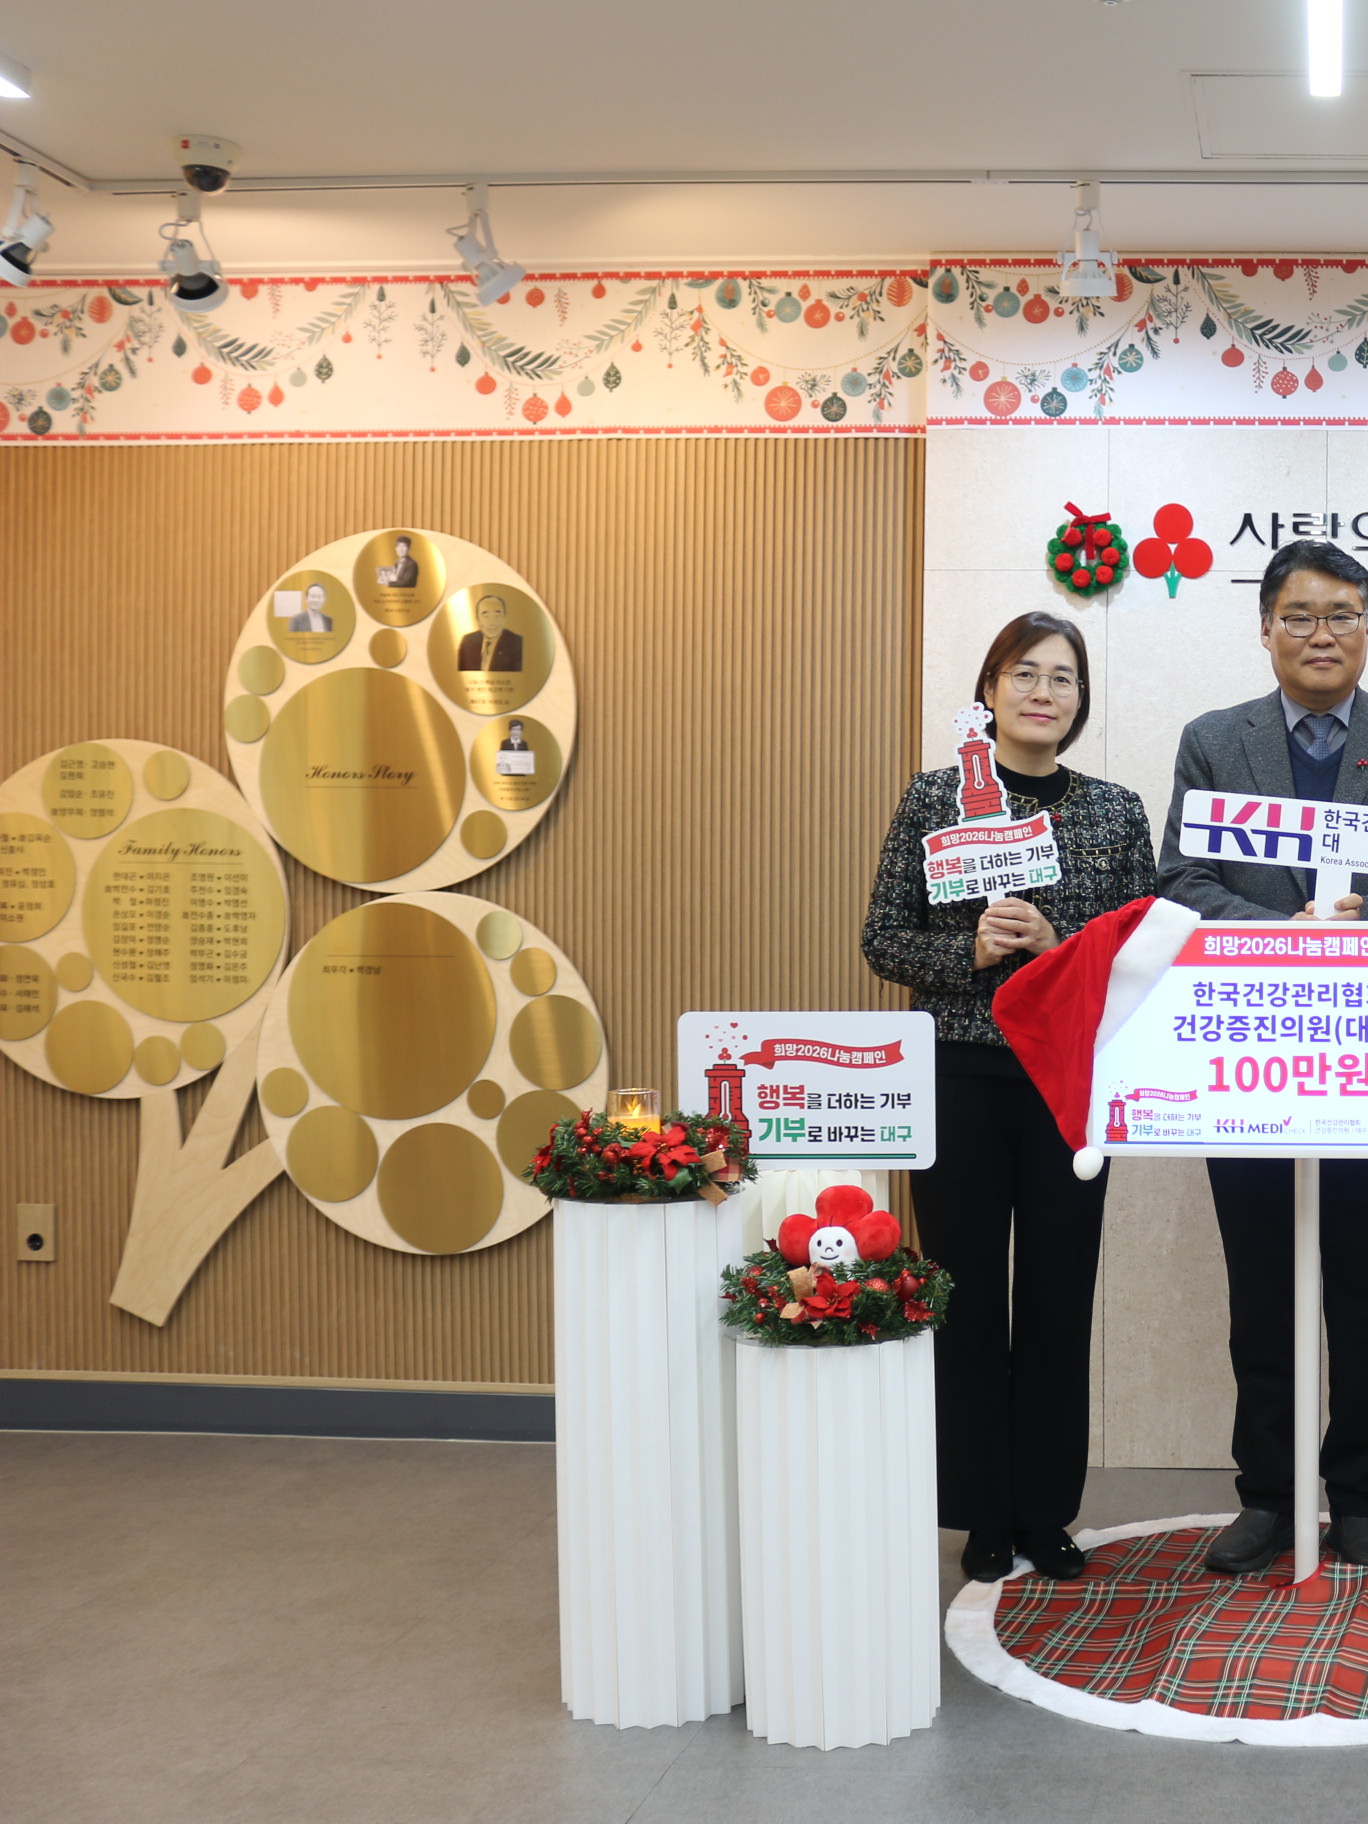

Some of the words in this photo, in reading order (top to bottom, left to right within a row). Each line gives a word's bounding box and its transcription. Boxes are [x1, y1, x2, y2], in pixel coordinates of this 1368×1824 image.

[305, 765, 365, 780] Honors
[940, 825, 1033, 847] 희망2026나눔캠페인
[1183, 797, 1316, 862] KH
[118, 839, 180, 862] Family
[183, 842, 241, 857] Honors
[927, 856, 977, 880] 행복을
[979, 851, 1022, 871] 더하는
[1026, 843, 1055, 862] 기부
[1320, 855, 1343, 867] Korea
[930, 877, 980, 900] 기부로
[982, 872, 1026, 892] 바꾸는
[1029, 865, 1058, 884] 대구
[773, 1043, 886, 1064] 희망2026나눔캠페인
[756, 1083, 822, 1110] 행복을
[826, 1092, 876, 1110] 더하는
[879, 1092, 912, 1110] 기부
[1131, 1108, 1161, 1121] 행복을
[1162, 1113, 1185, 1121] 더하는
[1187, 1113, 1202, 1121] 기부
[758, 1117, 823, 1143] 기부로
[827, 1126, 876, 1143] 바꾸는
[880, 1125, 913, 1143] 대구
[1131, 1124, 1161, 1137] 기부로
[1162, 1128, 1185, 1137] 바꾸는
[1186, 1128, 1202, 1137] 대구
[1213, 1118, 1245, 1134] KH
[1247, 1123, 1283, 1134] MEDI
